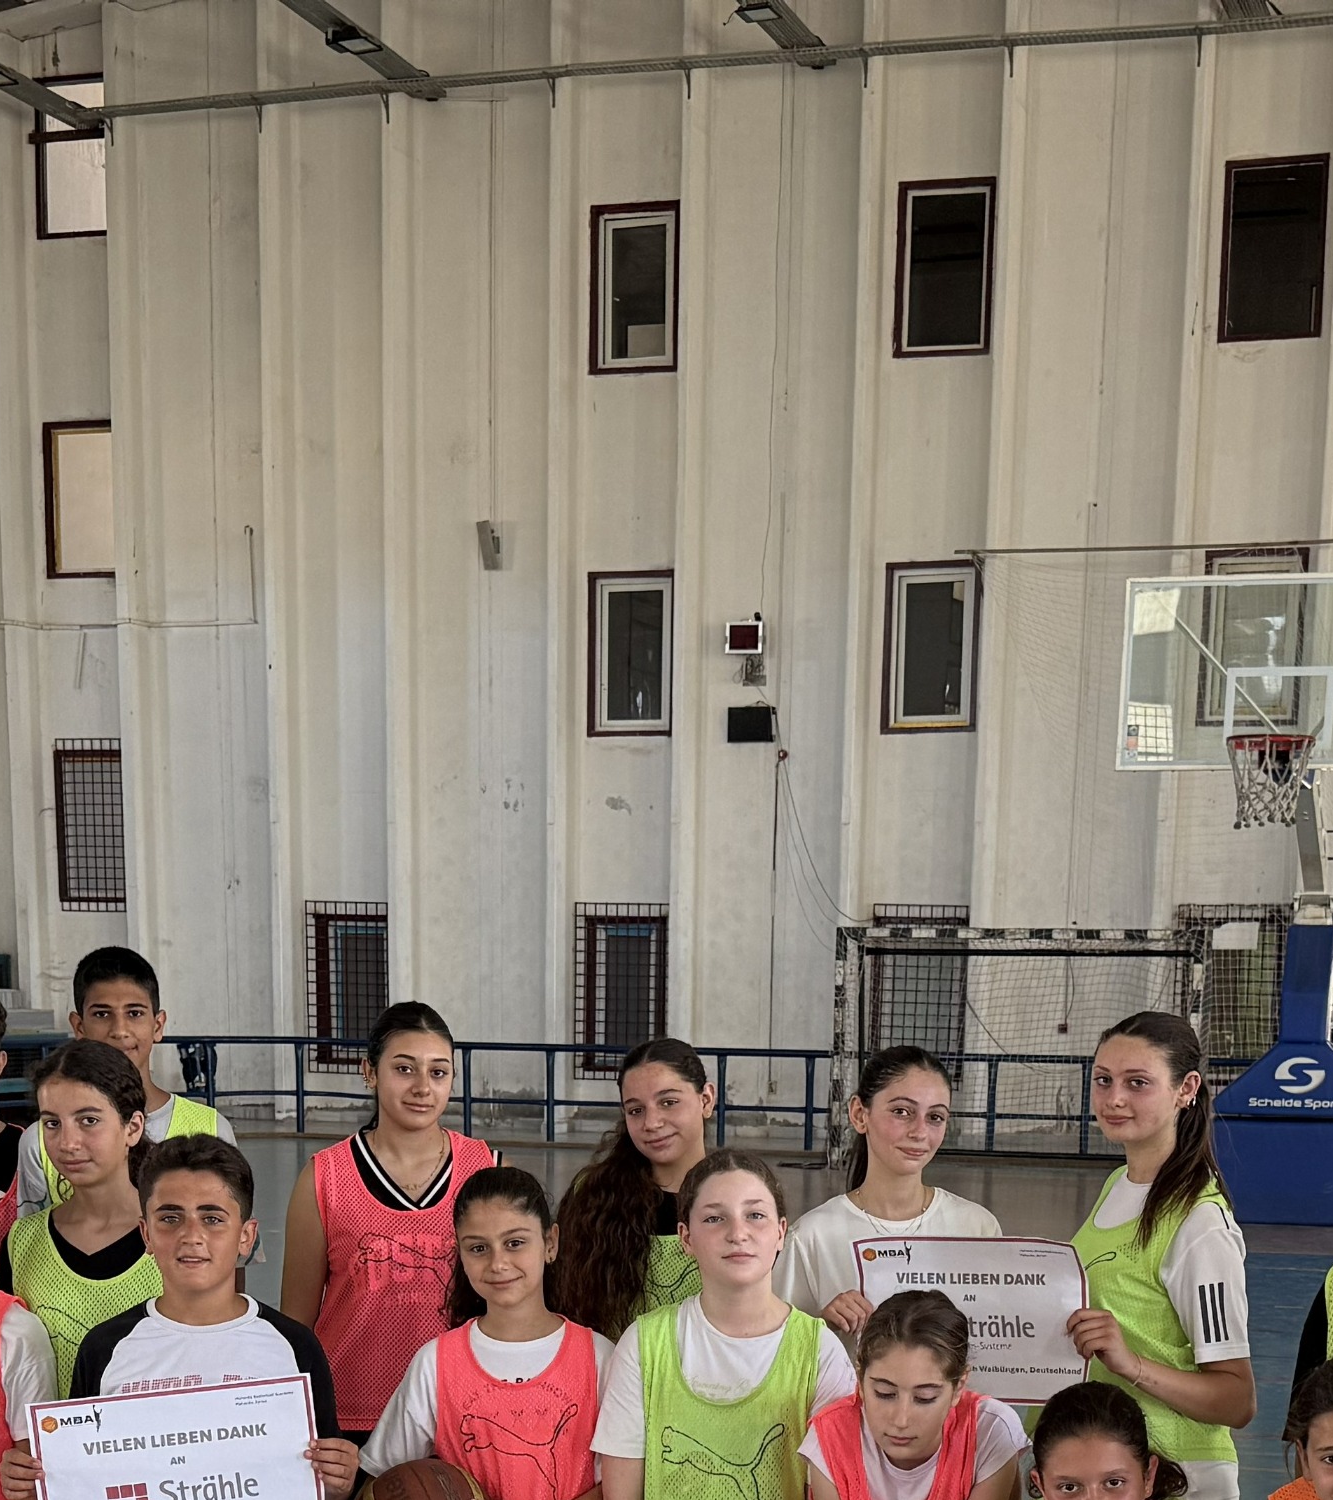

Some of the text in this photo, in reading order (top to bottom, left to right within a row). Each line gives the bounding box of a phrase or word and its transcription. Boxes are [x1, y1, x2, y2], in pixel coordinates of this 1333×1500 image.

[1248, 1097, 1302, 1108] Schelde
[896, 1271, 1046, 1286] VIELEN LIEBEN DANK
[963, 1294, 976, 1302] AN
[967, 1315, 1036, 1338] trähle
[1029, 1366, 1082, 1376] Deutschland
[59, 1415, 94, 1427] MBA
[83, 1423, 267, 1456] VIELEN LIEBEN DANK
[170, 1456, 186, 1465] AN
